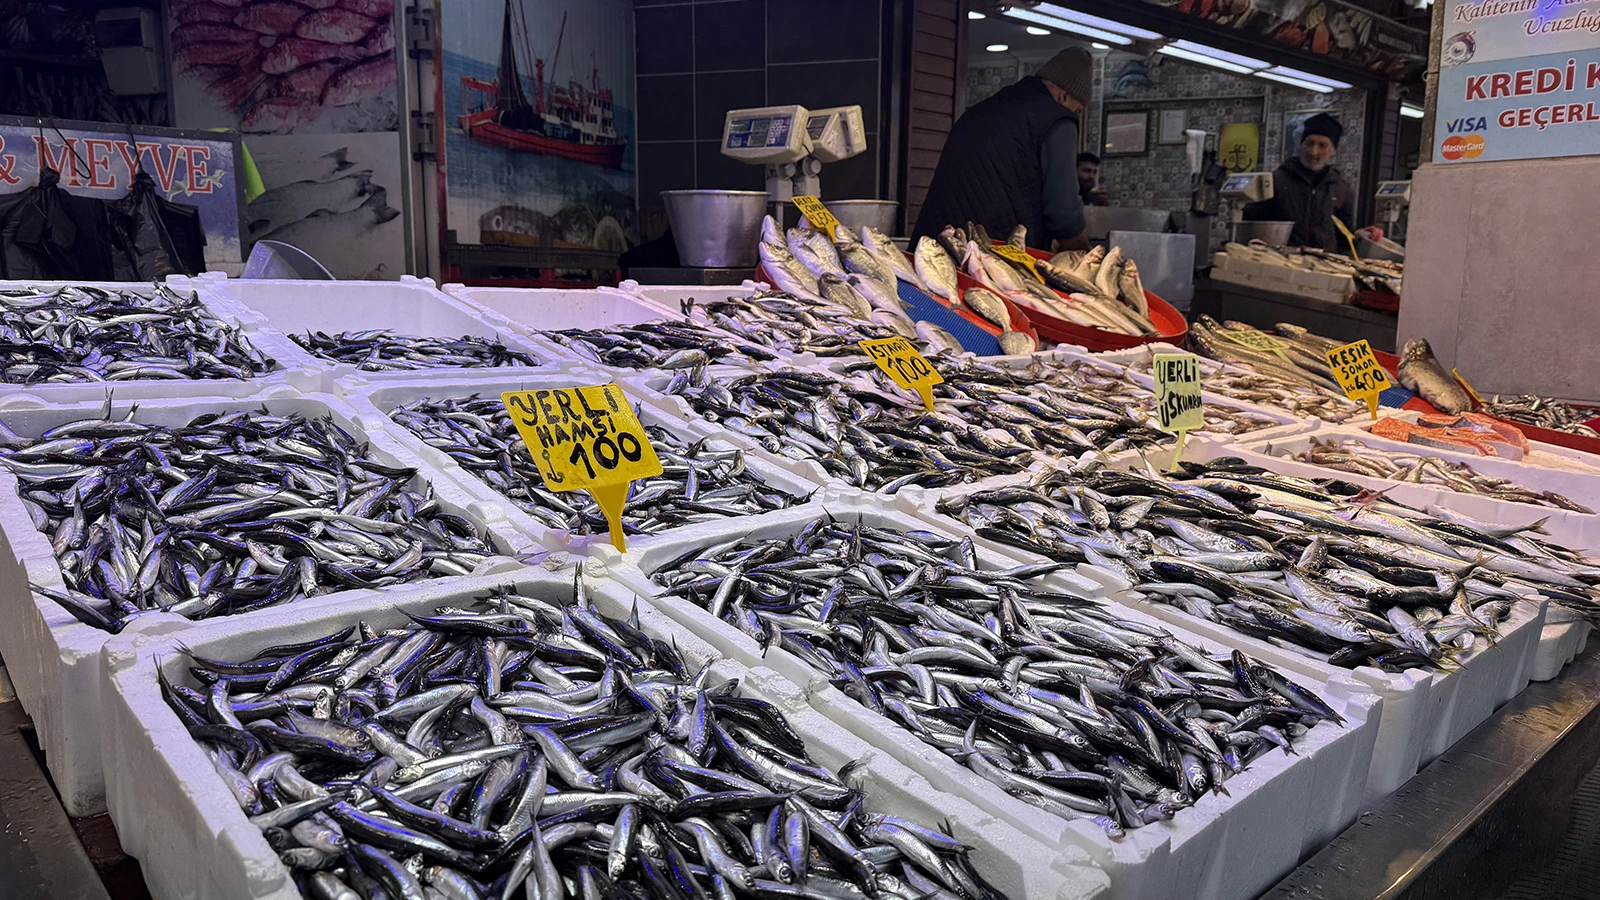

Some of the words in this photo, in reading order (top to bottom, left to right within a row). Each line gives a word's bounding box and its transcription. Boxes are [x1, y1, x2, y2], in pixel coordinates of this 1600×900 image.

[1455, 0, 1538, 22] Kalitenin
[1465, 58, 1576, 101] KREDİ
[1446, 116, 1487, 133] VISA
[1441, 142, 1485, 153] MasterCard
[32, 135, 213, 194] MEYVE
[1329, 343, 1370, 368] KESİK
[887, 355, 931, 383] 100
[1156, 358, 1197, 401] YERLİ
[1354, 369, 1385, 391] 400
[569, 431, 642, 480] 100
